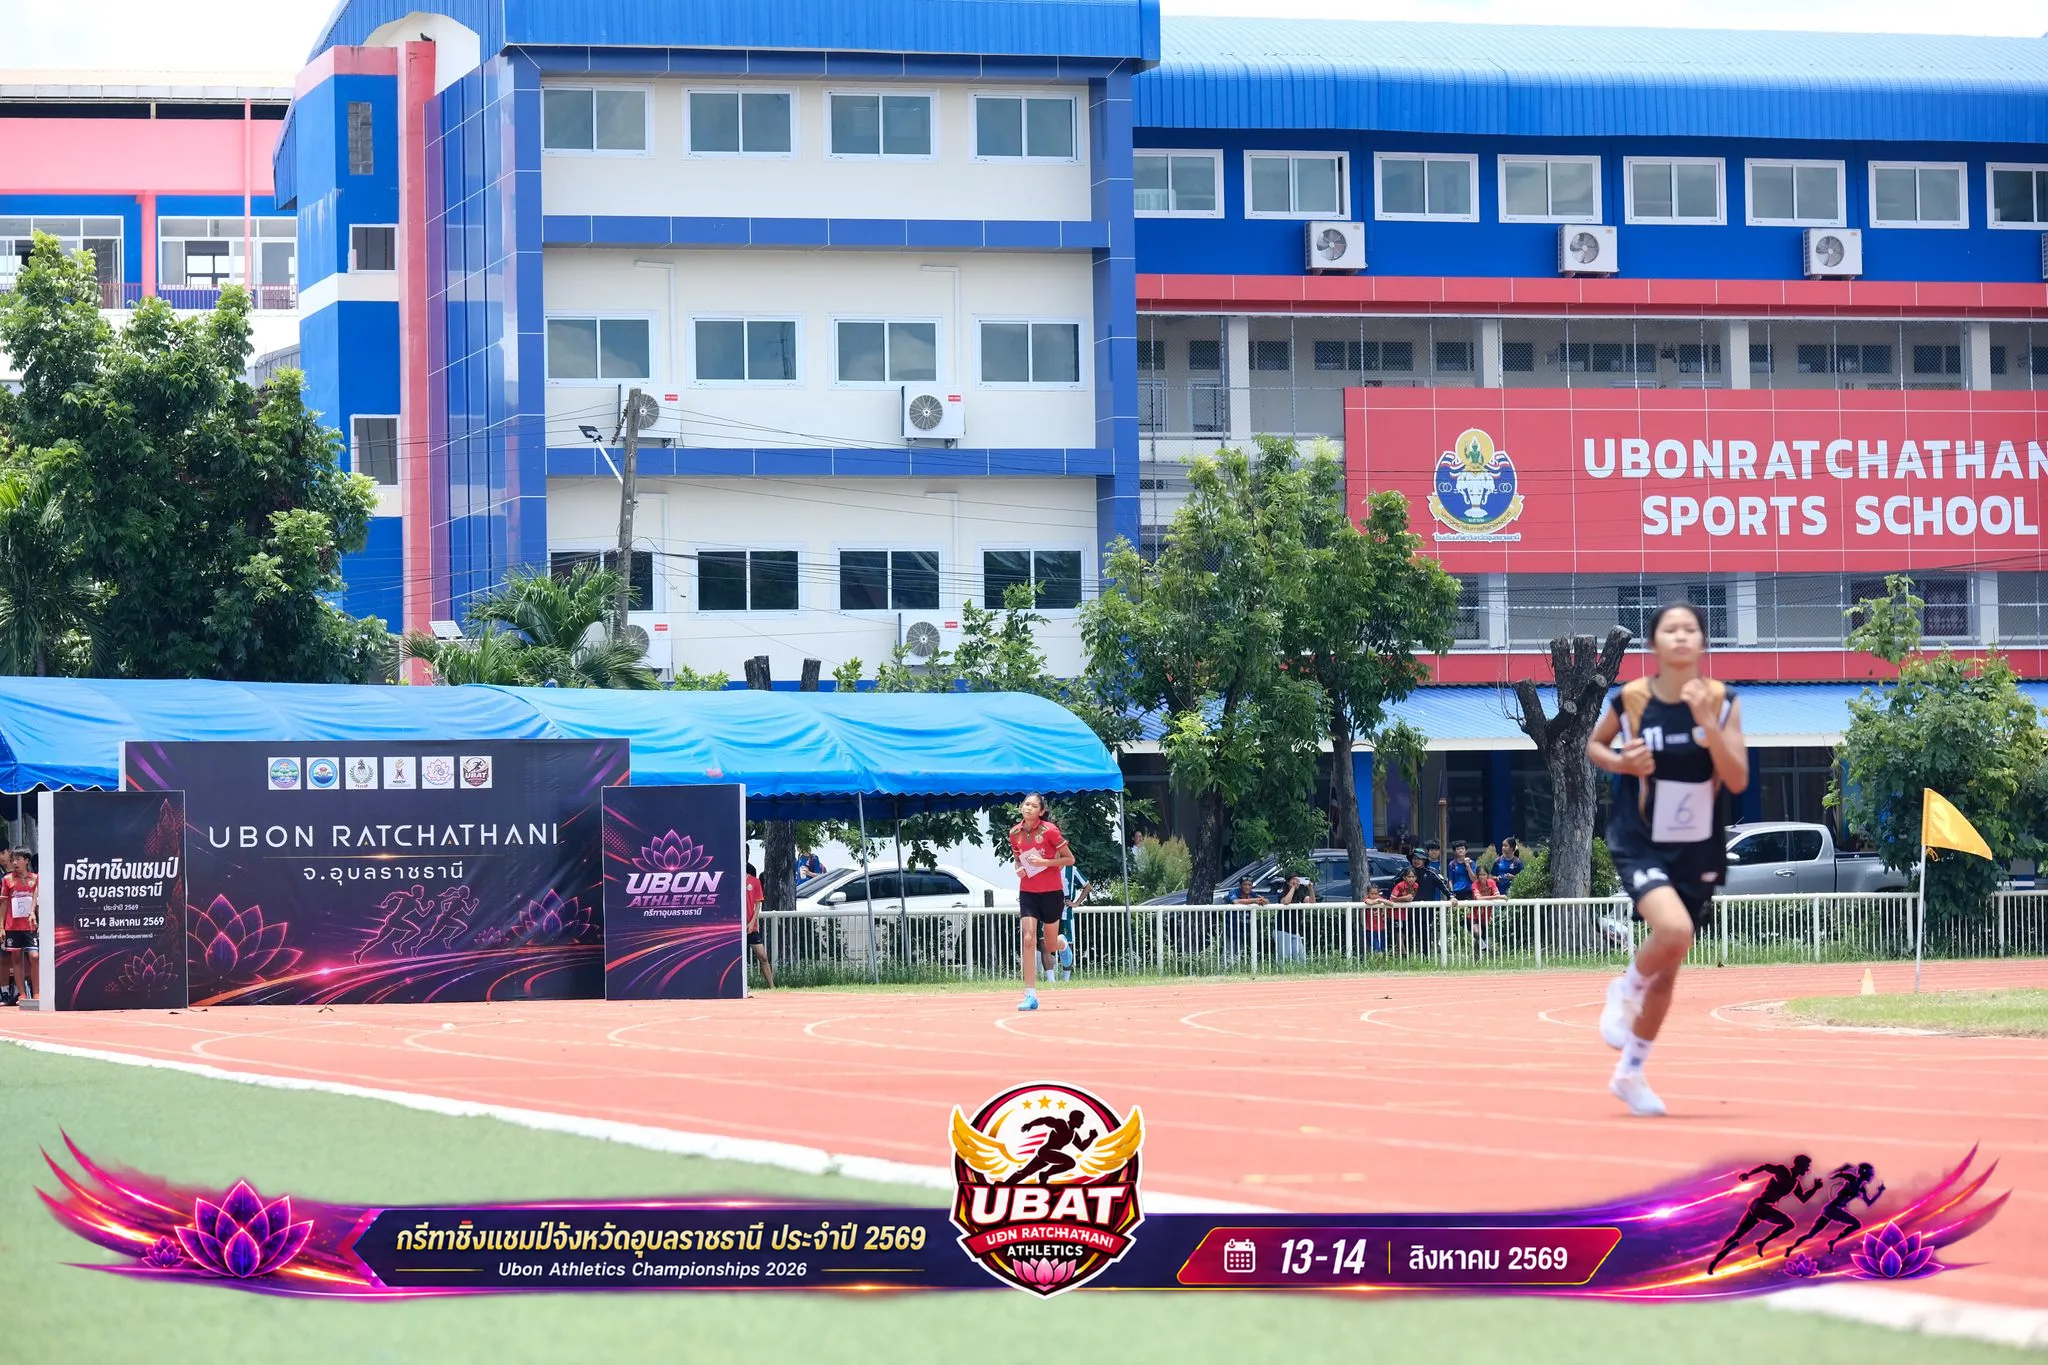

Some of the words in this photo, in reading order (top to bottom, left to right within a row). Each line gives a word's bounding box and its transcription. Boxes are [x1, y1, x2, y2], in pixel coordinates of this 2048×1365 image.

[1642, 496, 1827, 536] SPORTS
[1855, 495, 2038, 535] SCHOOL
[1674, 792, 1695, 826] 6
[209, 825, 314, 848] UBON
[332, 823, 558, 847] RATCHATHANI
[303, 861, 464, 886] จ.อุบลราชธานี
[626, 871, 724, 894] UBON
[627, 894, 719, 907] ATHLETICS
[109, 917, 141, 927] สิงหาคม
[143, 917, 165, 926] 2569
